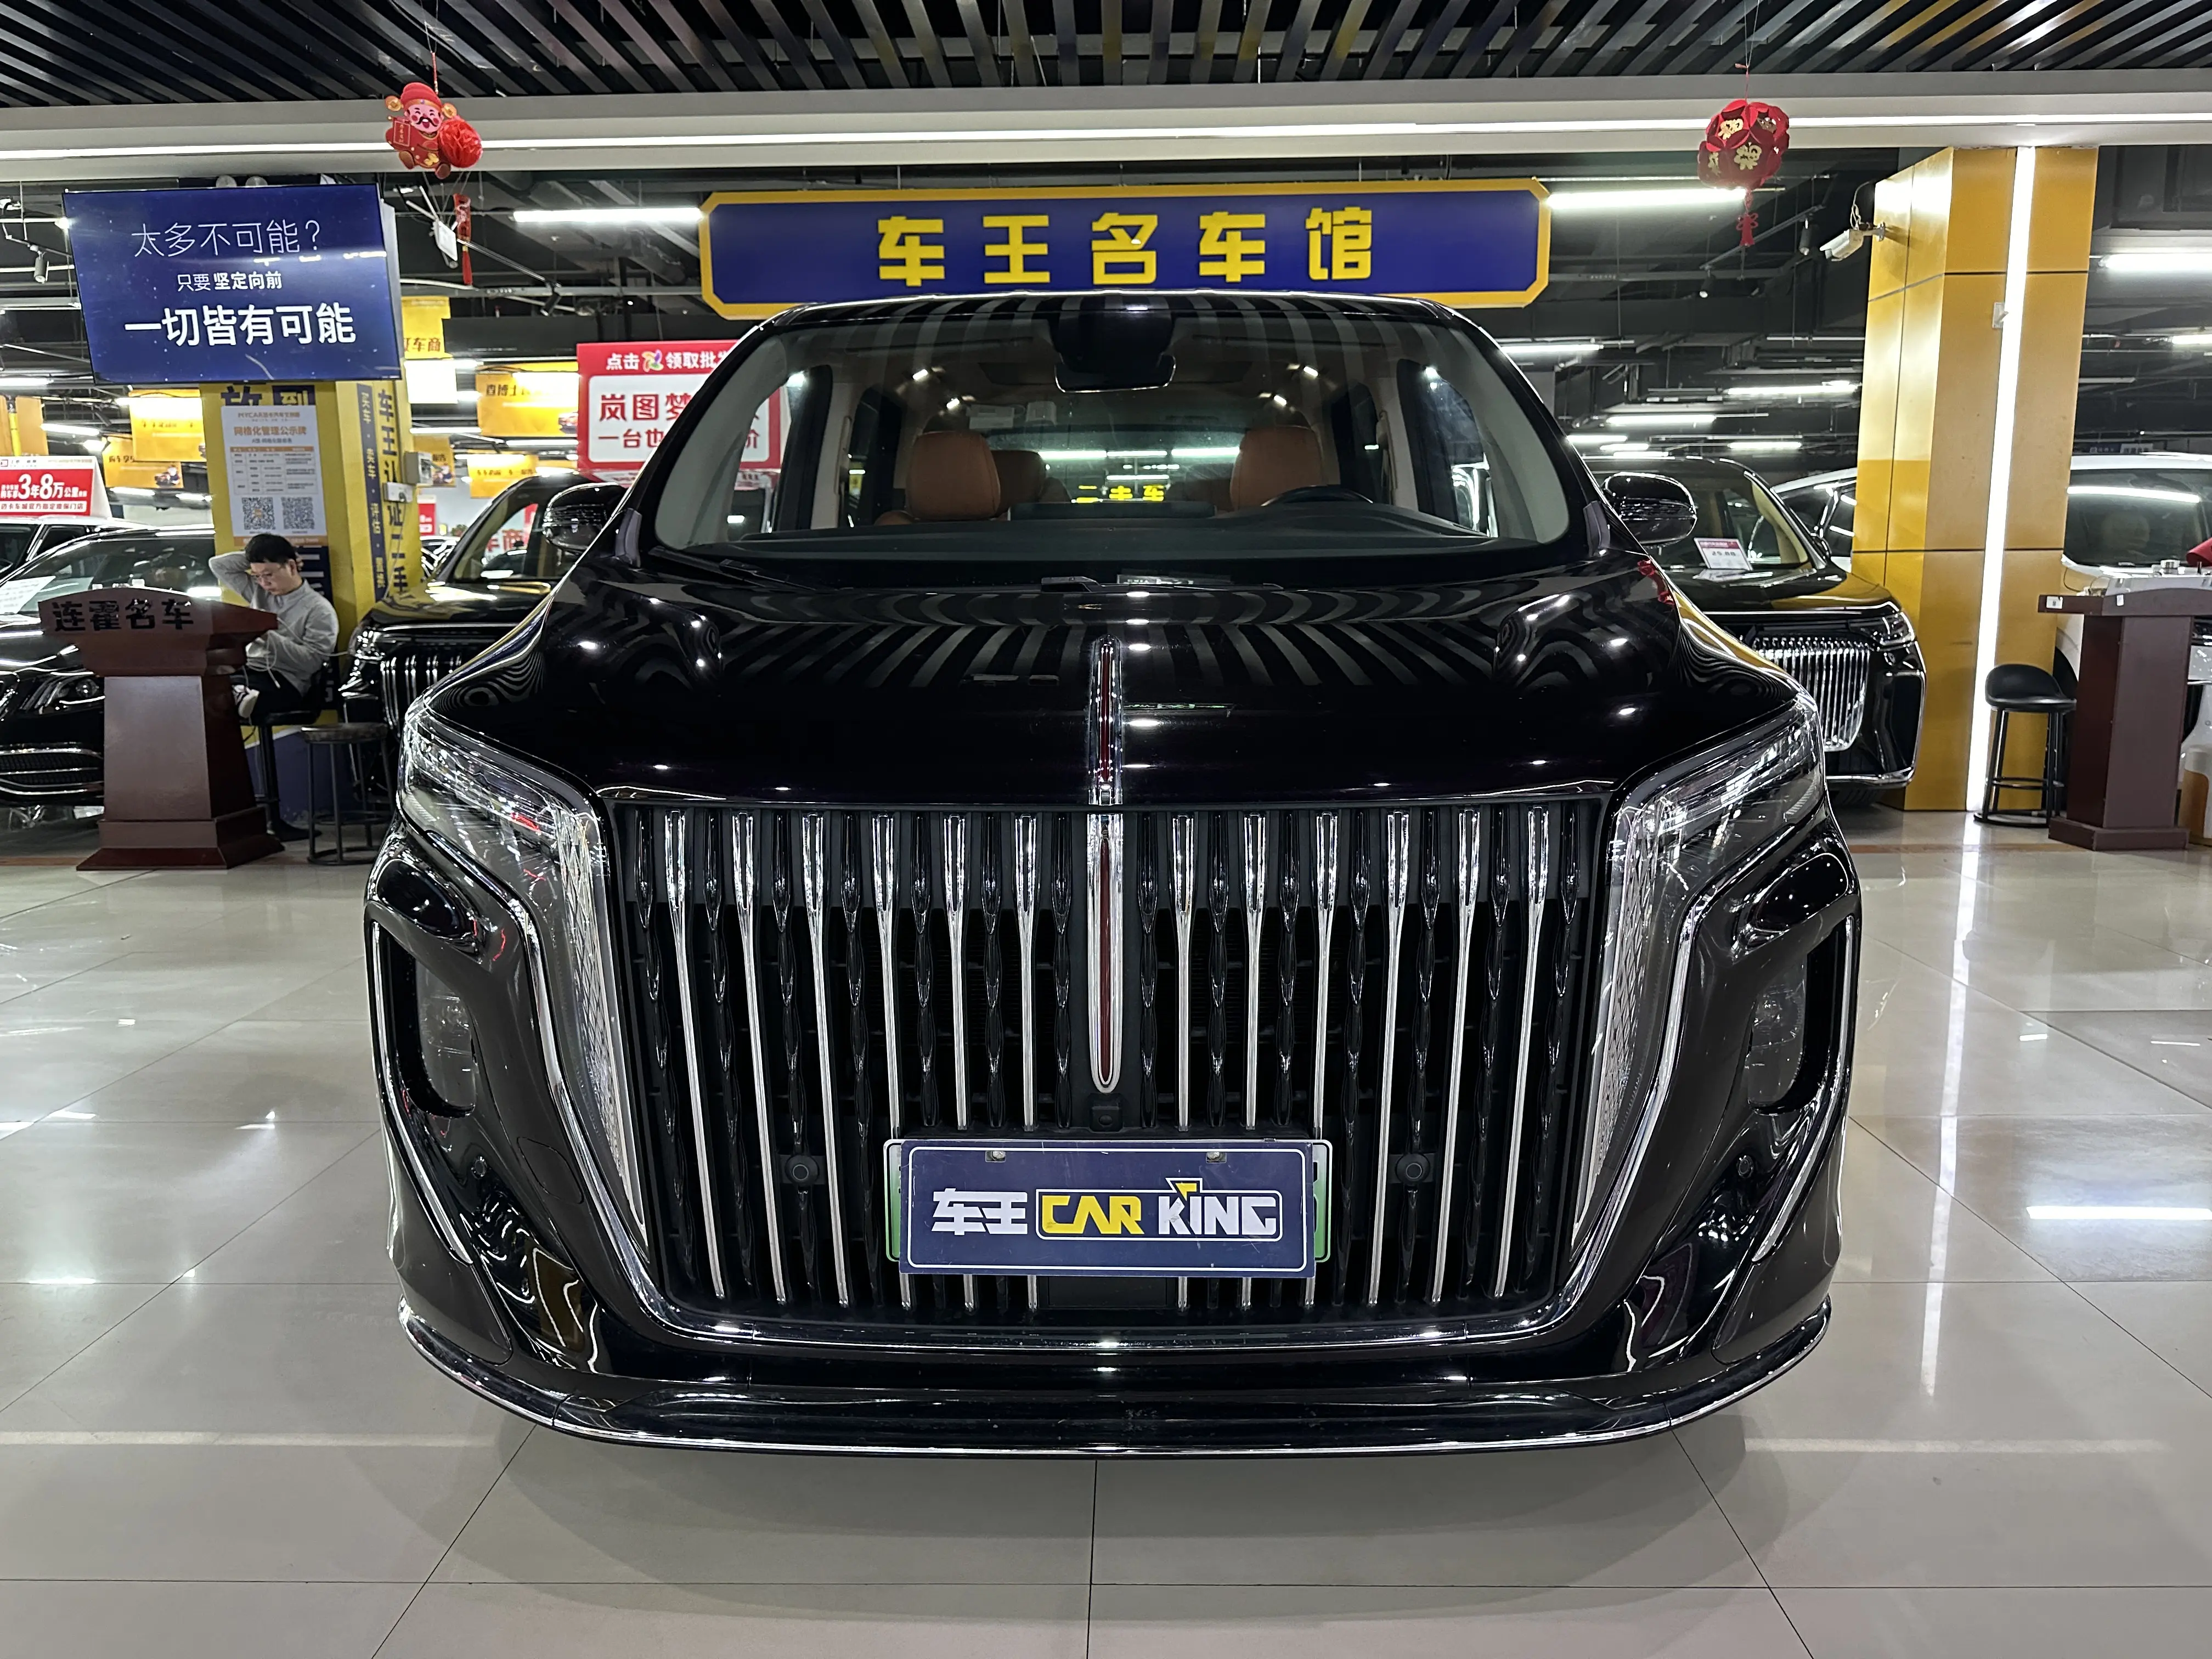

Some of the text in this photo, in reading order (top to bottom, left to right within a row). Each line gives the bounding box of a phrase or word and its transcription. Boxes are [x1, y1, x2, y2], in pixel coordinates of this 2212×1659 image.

[132, 219, 320, 257] 太多不可能？
[878, 206, 1372, 287] 车王名车馆
[125, 302, 356, 347] 一切皆有可能
[606, 353, 640, 370] 点击
[932, 1188, 1277, 1235] 车王 CAR KING
